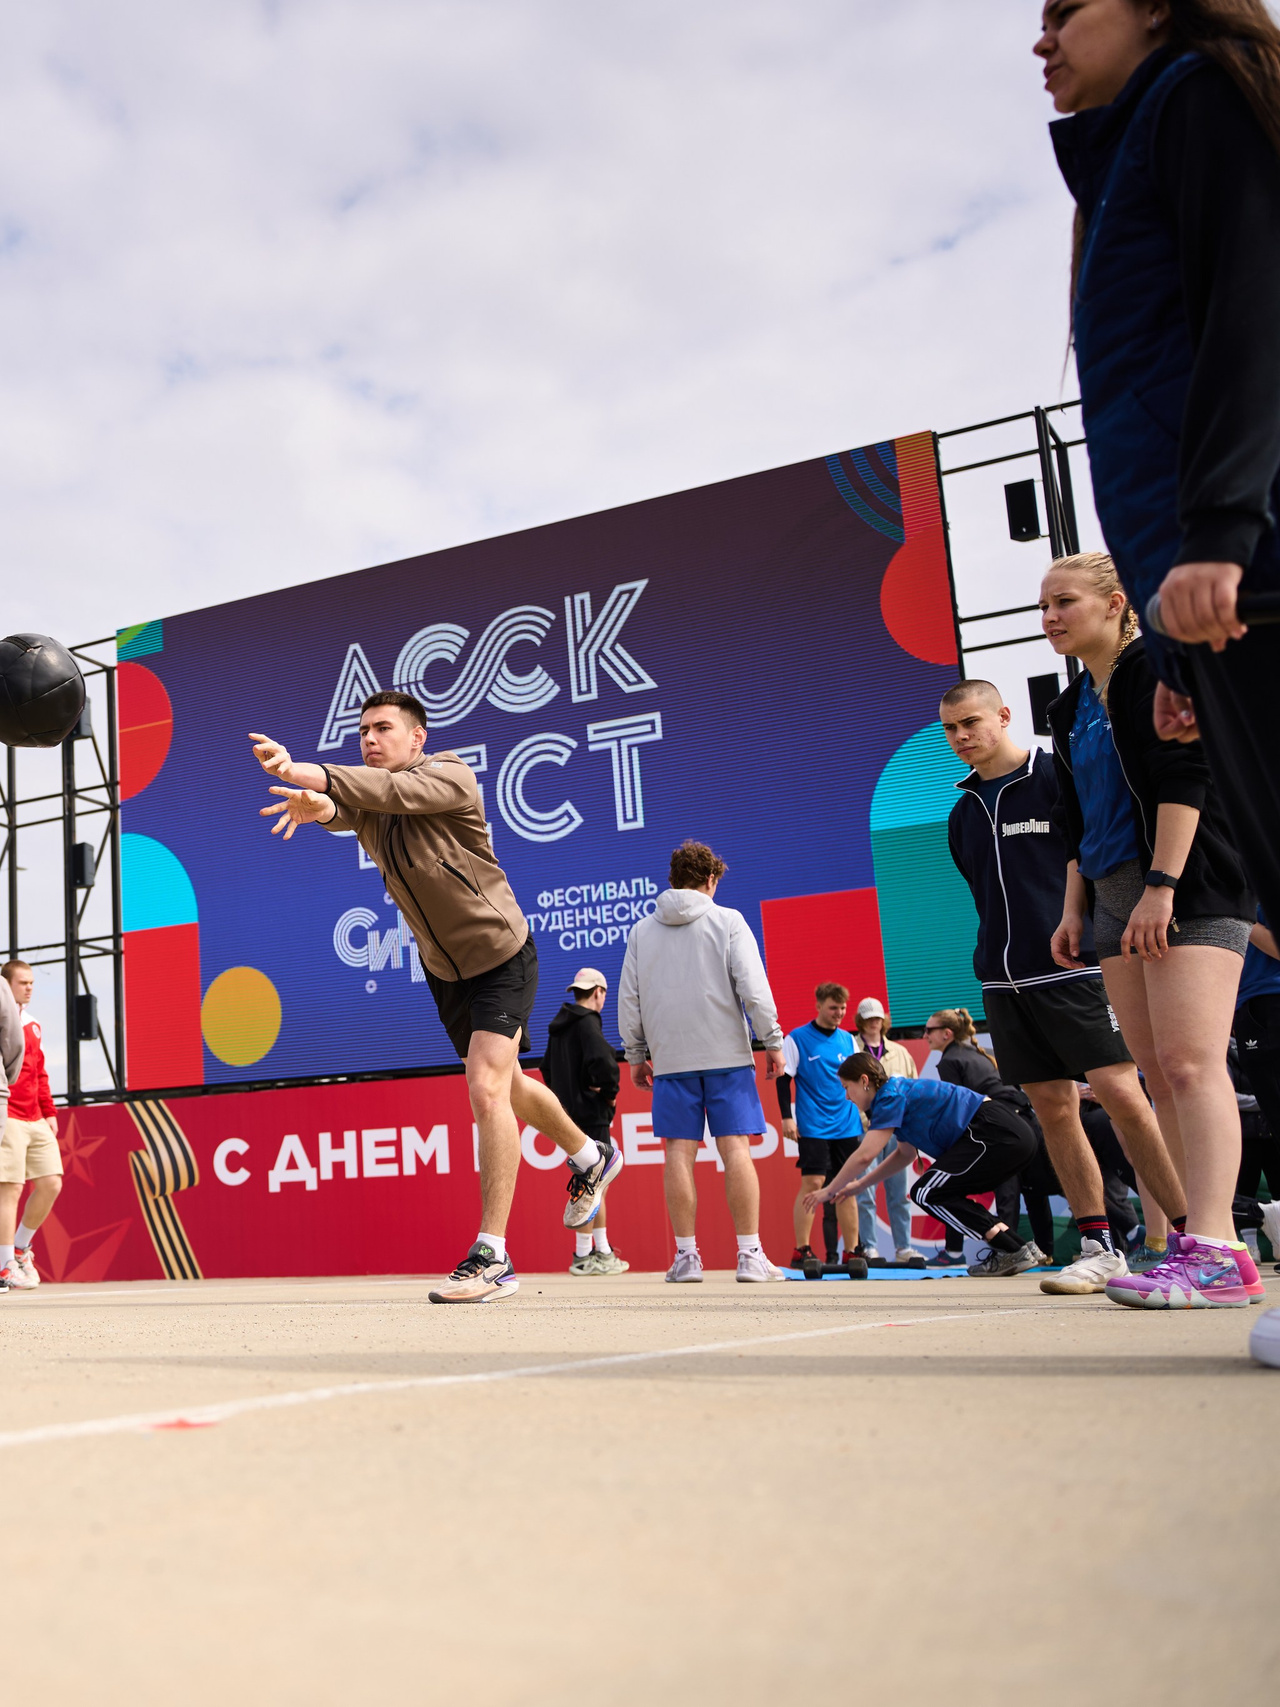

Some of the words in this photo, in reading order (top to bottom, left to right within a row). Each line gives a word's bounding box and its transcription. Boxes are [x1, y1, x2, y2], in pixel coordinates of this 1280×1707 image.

[316, 578, 659, 752] АССК
[536, 876, 659, 909] ФЕСТИВАЛЬ
[524, 898, 658, 933] ТУДЕНЧЕСКО
[558, 924, 636, 951] СПОРТ
[213, 1137, 251, 1186] С
[268, 1124, 451, 1193] ДНЕМ
